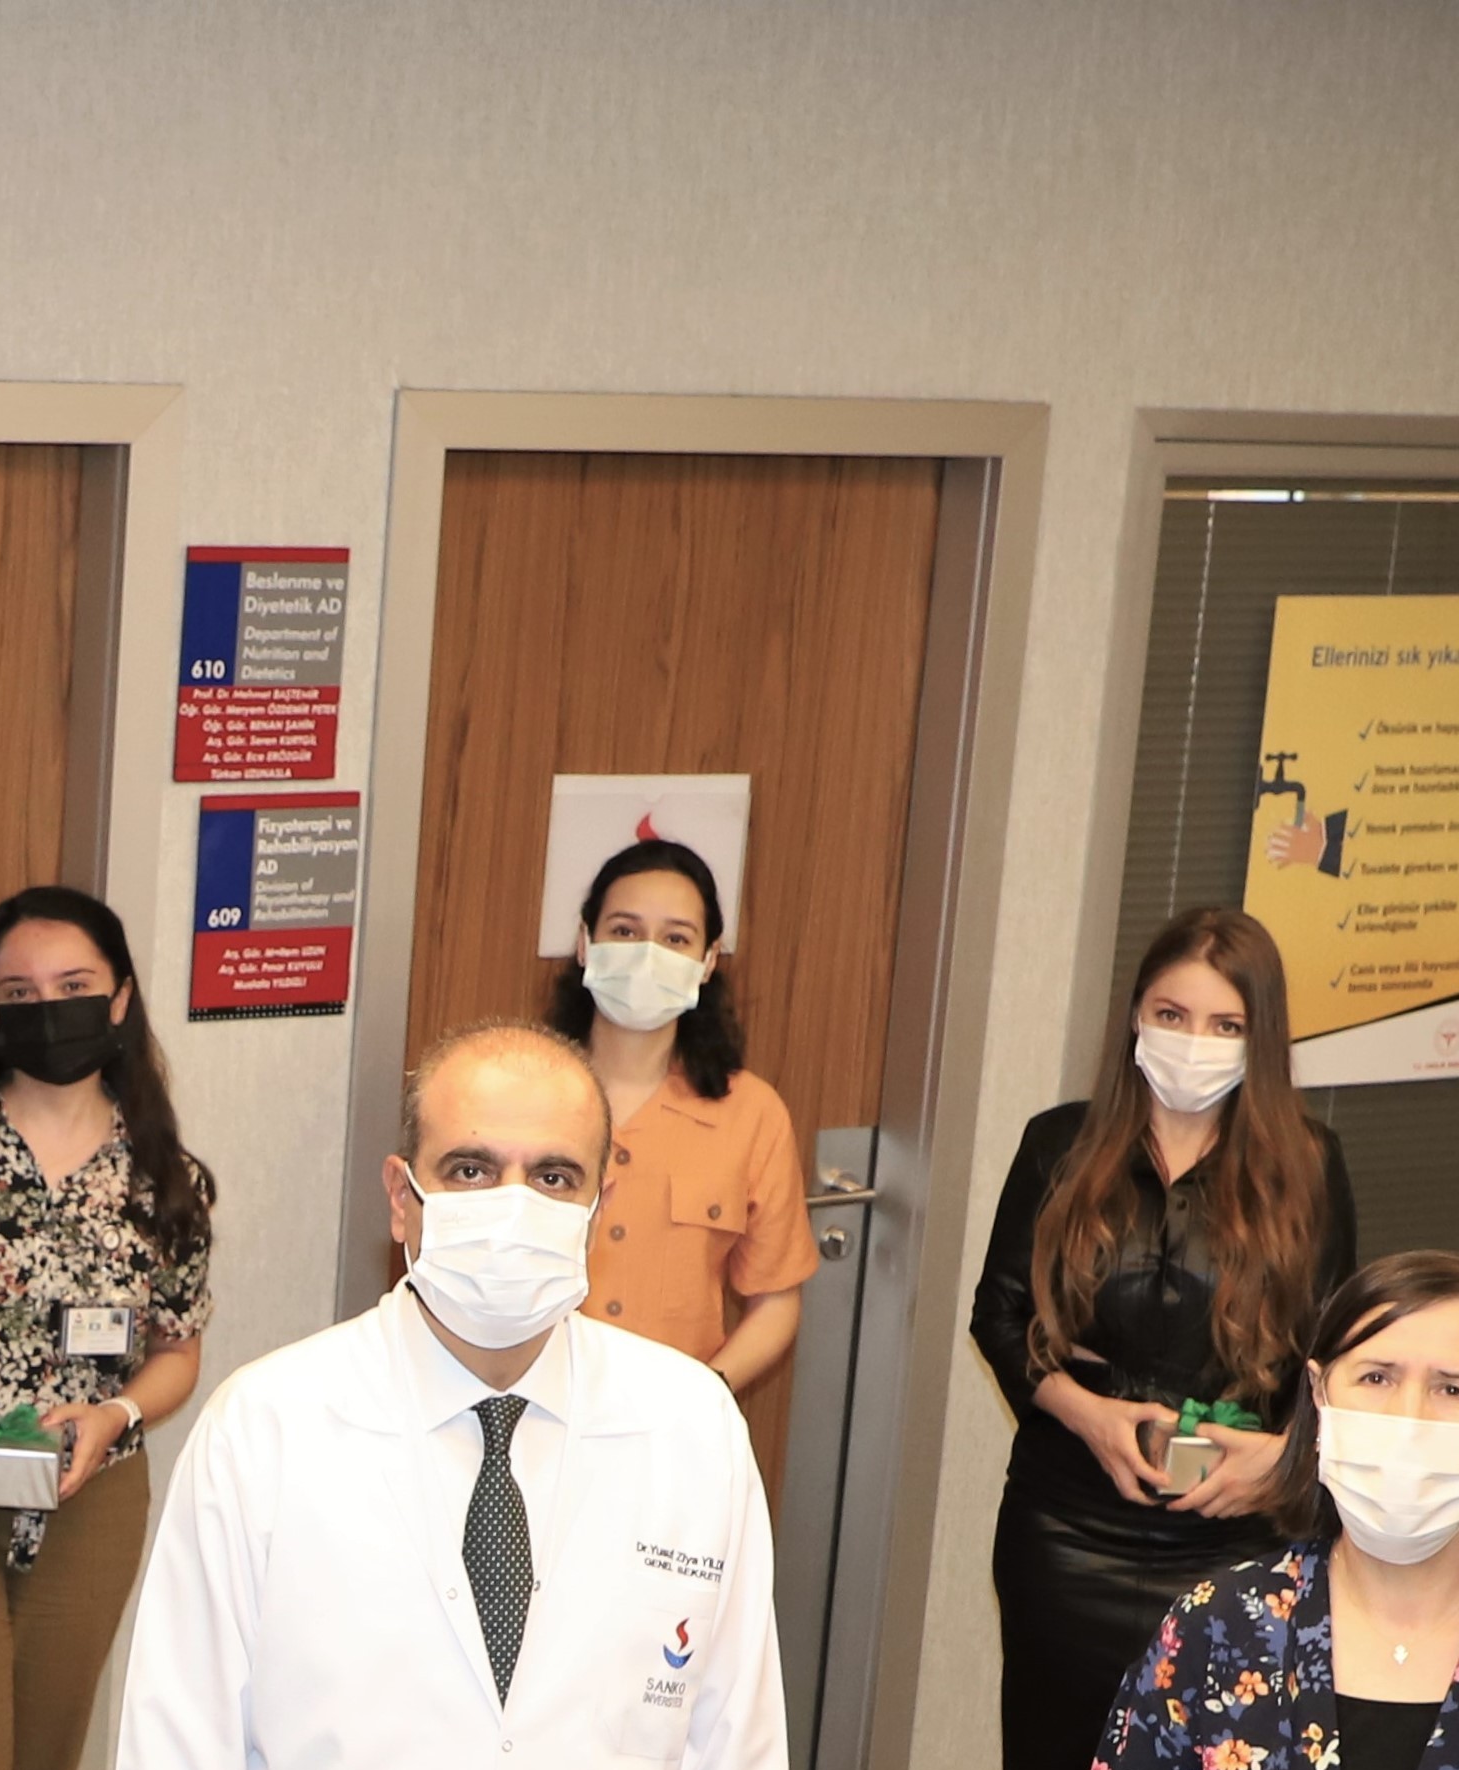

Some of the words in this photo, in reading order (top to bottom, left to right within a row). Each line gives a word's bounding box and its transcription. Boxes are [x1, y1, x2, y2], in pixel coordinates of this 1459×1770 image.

[246, 571, 322, 590] Beslenme
[326, 577, 345, 590] ve
[244, 596, 313, 617] Diyetetik
[317, 599, 342, 614] AD
[244, 626, 321, 642] Department
[323, 626, 338, 641] of
[242, 647, 300, 660] Nutrition
[303, 647, 329, 660] and
[1312, 645, 1390, 668] Ellerinizi
[1397, 646, 1420, 664] sık
[191, 660, 225, 679] 610
[241, 666, 296, 680] Dietetics
[259, 815, 332, 837] Fizyoterapi
[336, 818, 352, 830] ve
[257, 860, 278, 875] AD
[208, 907, 241, 927] 609
[644, 1557, 673, 1571] GENEL
[646, 1677, 686, 1695] SANKO
